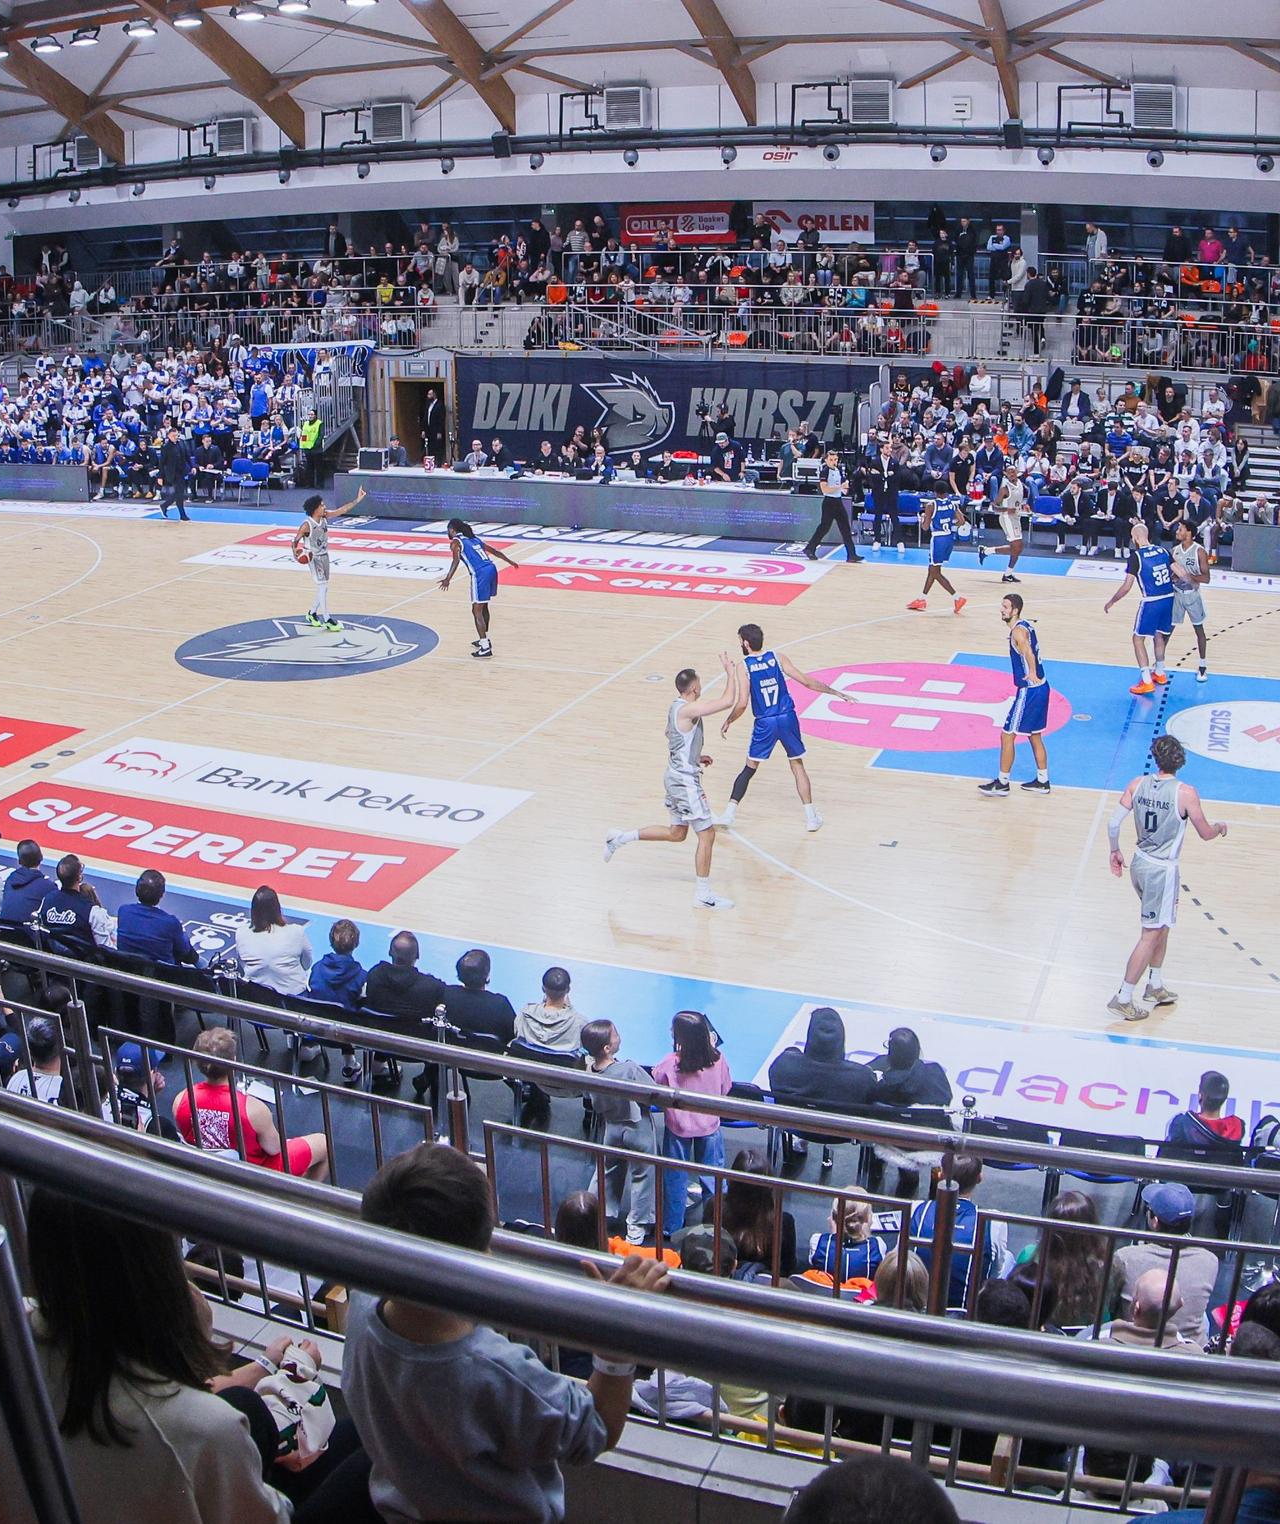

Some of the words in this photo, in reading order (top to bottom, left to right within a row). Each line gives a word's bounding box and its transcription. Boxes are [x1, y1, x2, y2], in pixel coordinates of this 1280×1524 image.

[797, 214, 870, 231] ORLEN
[472, 383, 573, 432] DZIKI
[686, 387, 859, 442] WARSZA
[544, 554, 728, 575] netuno
[608, 577, 758, 597] ORLEN
[1153, 569, 1170, 586] 32
[760, 684, 779, 708] 17
[1207, 709, 1232, 752] SUZUKI
[196, 765, 322, 801] Bank
[324, 784, 485, 823] Pekao
[1144, 810, 1158, 833] 0
[8, 797, 406, 883] SUPERBET
